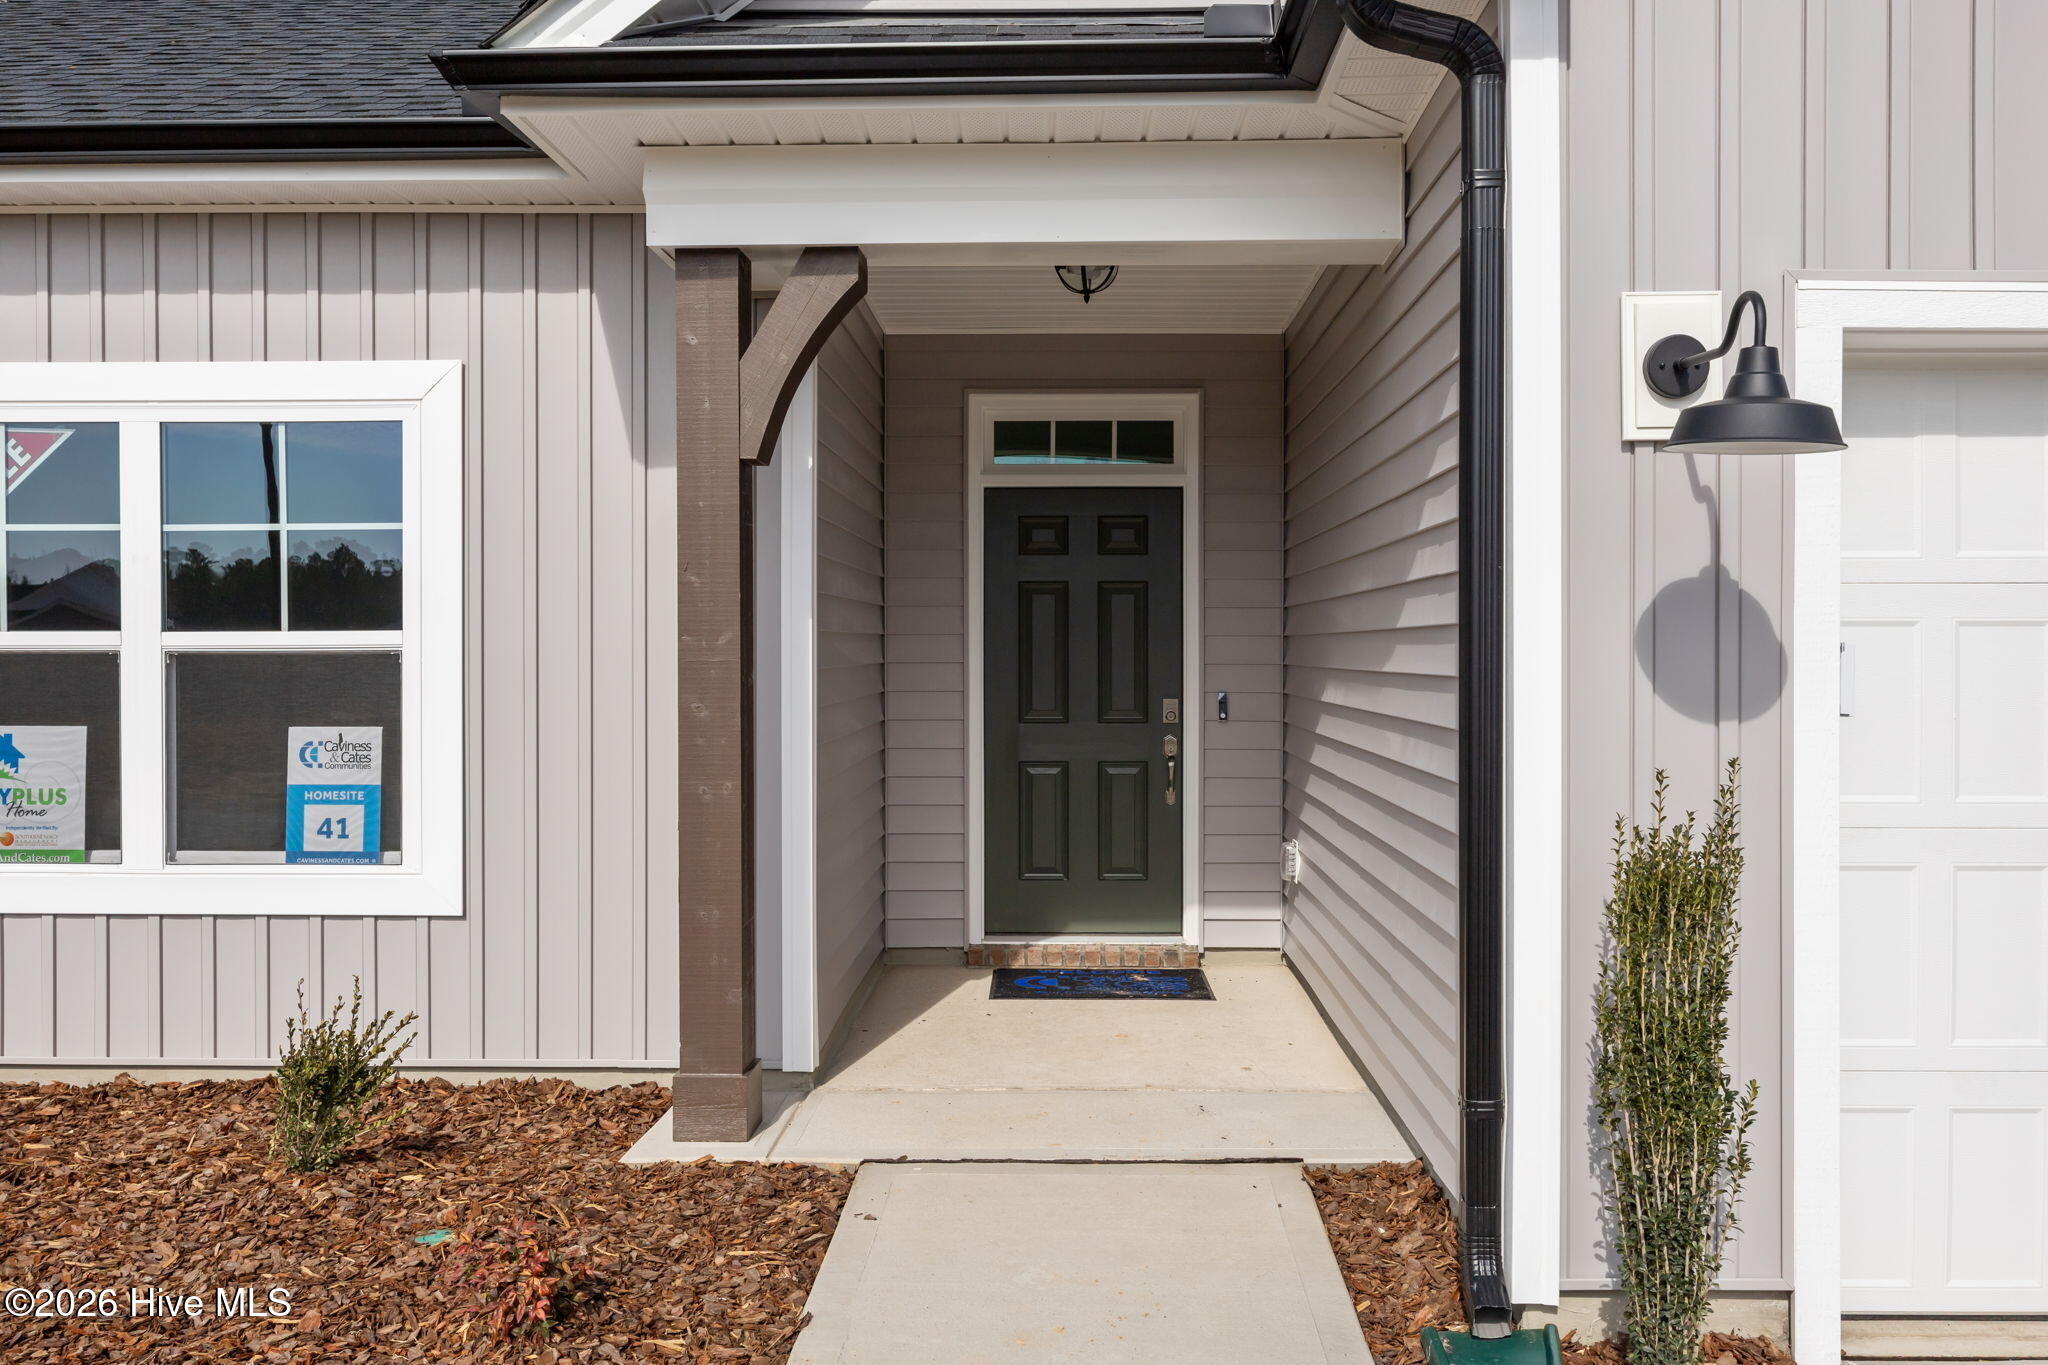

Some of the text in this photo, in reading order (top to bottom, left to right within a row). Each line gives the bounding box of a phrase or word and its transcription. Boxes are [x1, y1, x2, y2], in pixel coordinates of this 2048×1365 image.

[324, 740, 372, 752] Caviness
[330, 752, 372, 763] & Cates
[324, 762, 372, 770] Communities
[304, 790, 365, 801] HOMESITE
[6, 800, 48, 818] Home
[316, 817, 350, 839] 41
